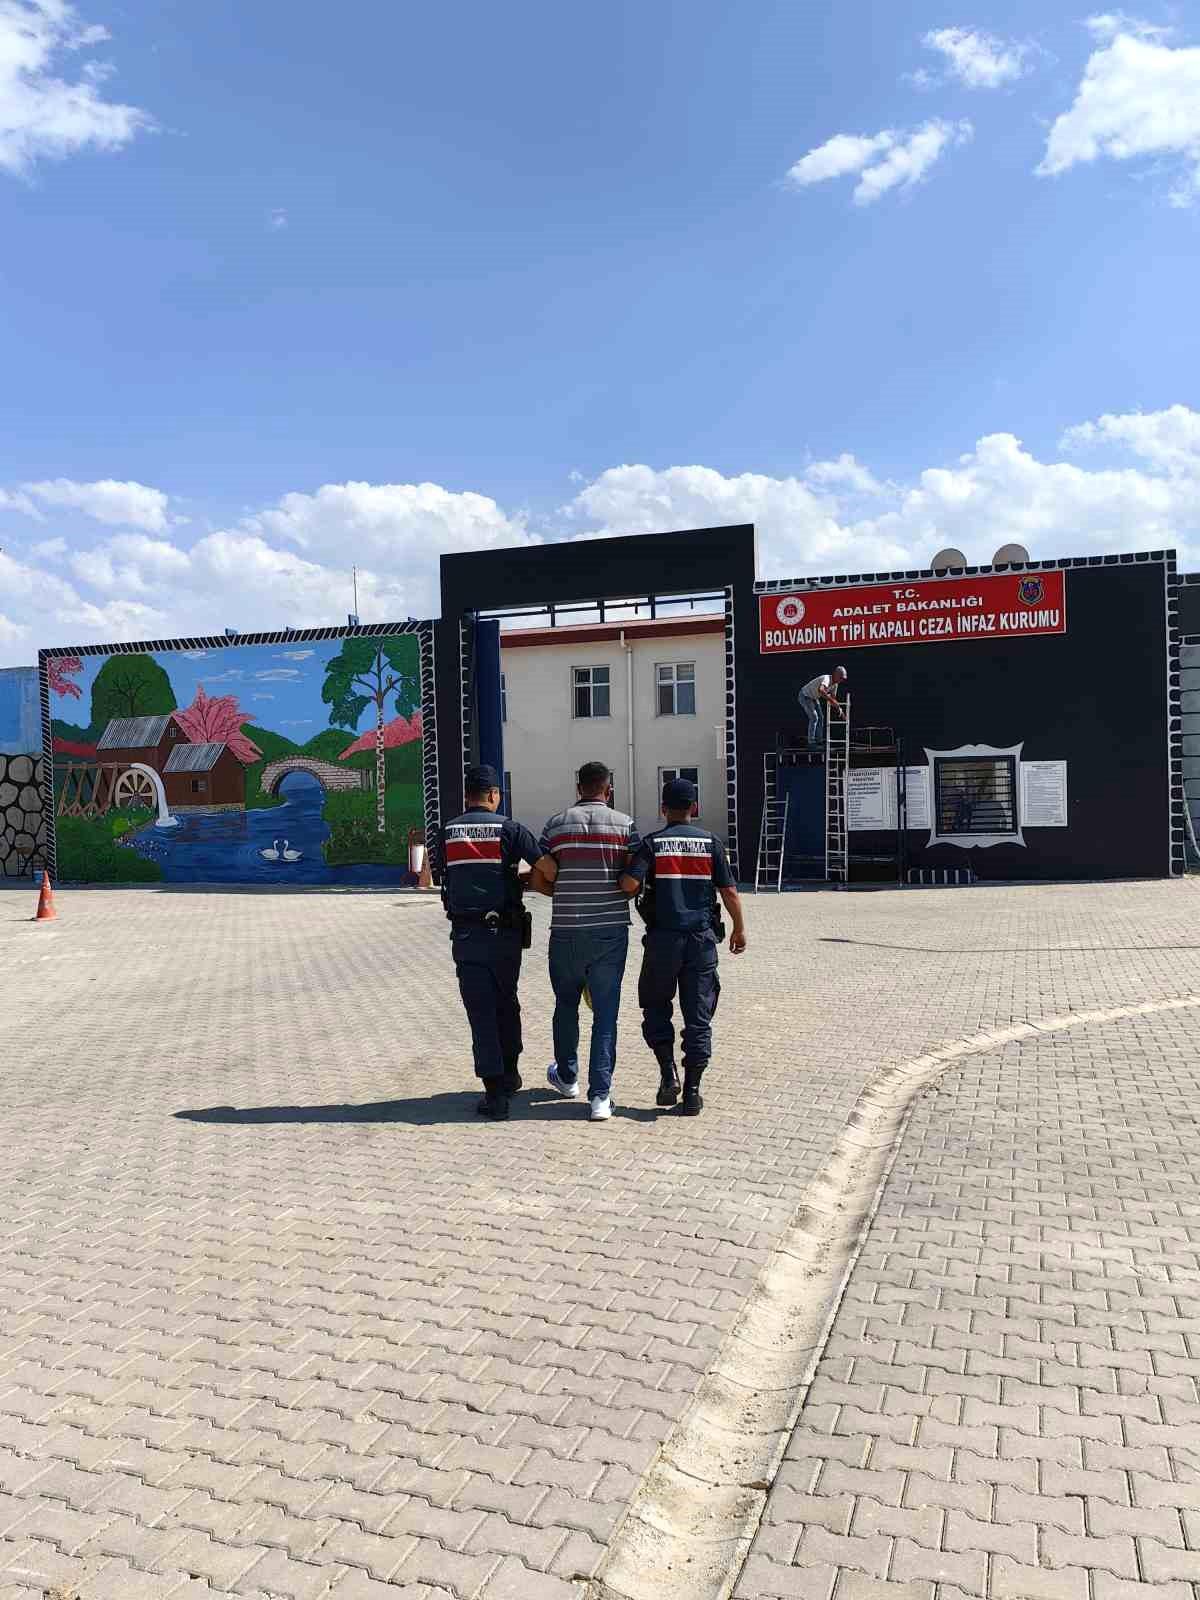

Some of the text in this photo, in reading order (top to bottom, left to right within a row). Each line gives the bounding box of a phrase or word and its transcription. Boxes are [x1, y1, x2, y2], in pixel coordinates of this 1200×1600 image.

[892, 589, 920, 600] T.C.
[832, 595, 983, 618] ADALET BAKANLIĞI
[765, 609, 1060, 647] BOLVADİN T TİPİ KAPALI CEZA İNFAZ KURUMU
[450, 827, 496, 838] JANDARMA
[660, 841, 707, 853] JANDARMA
